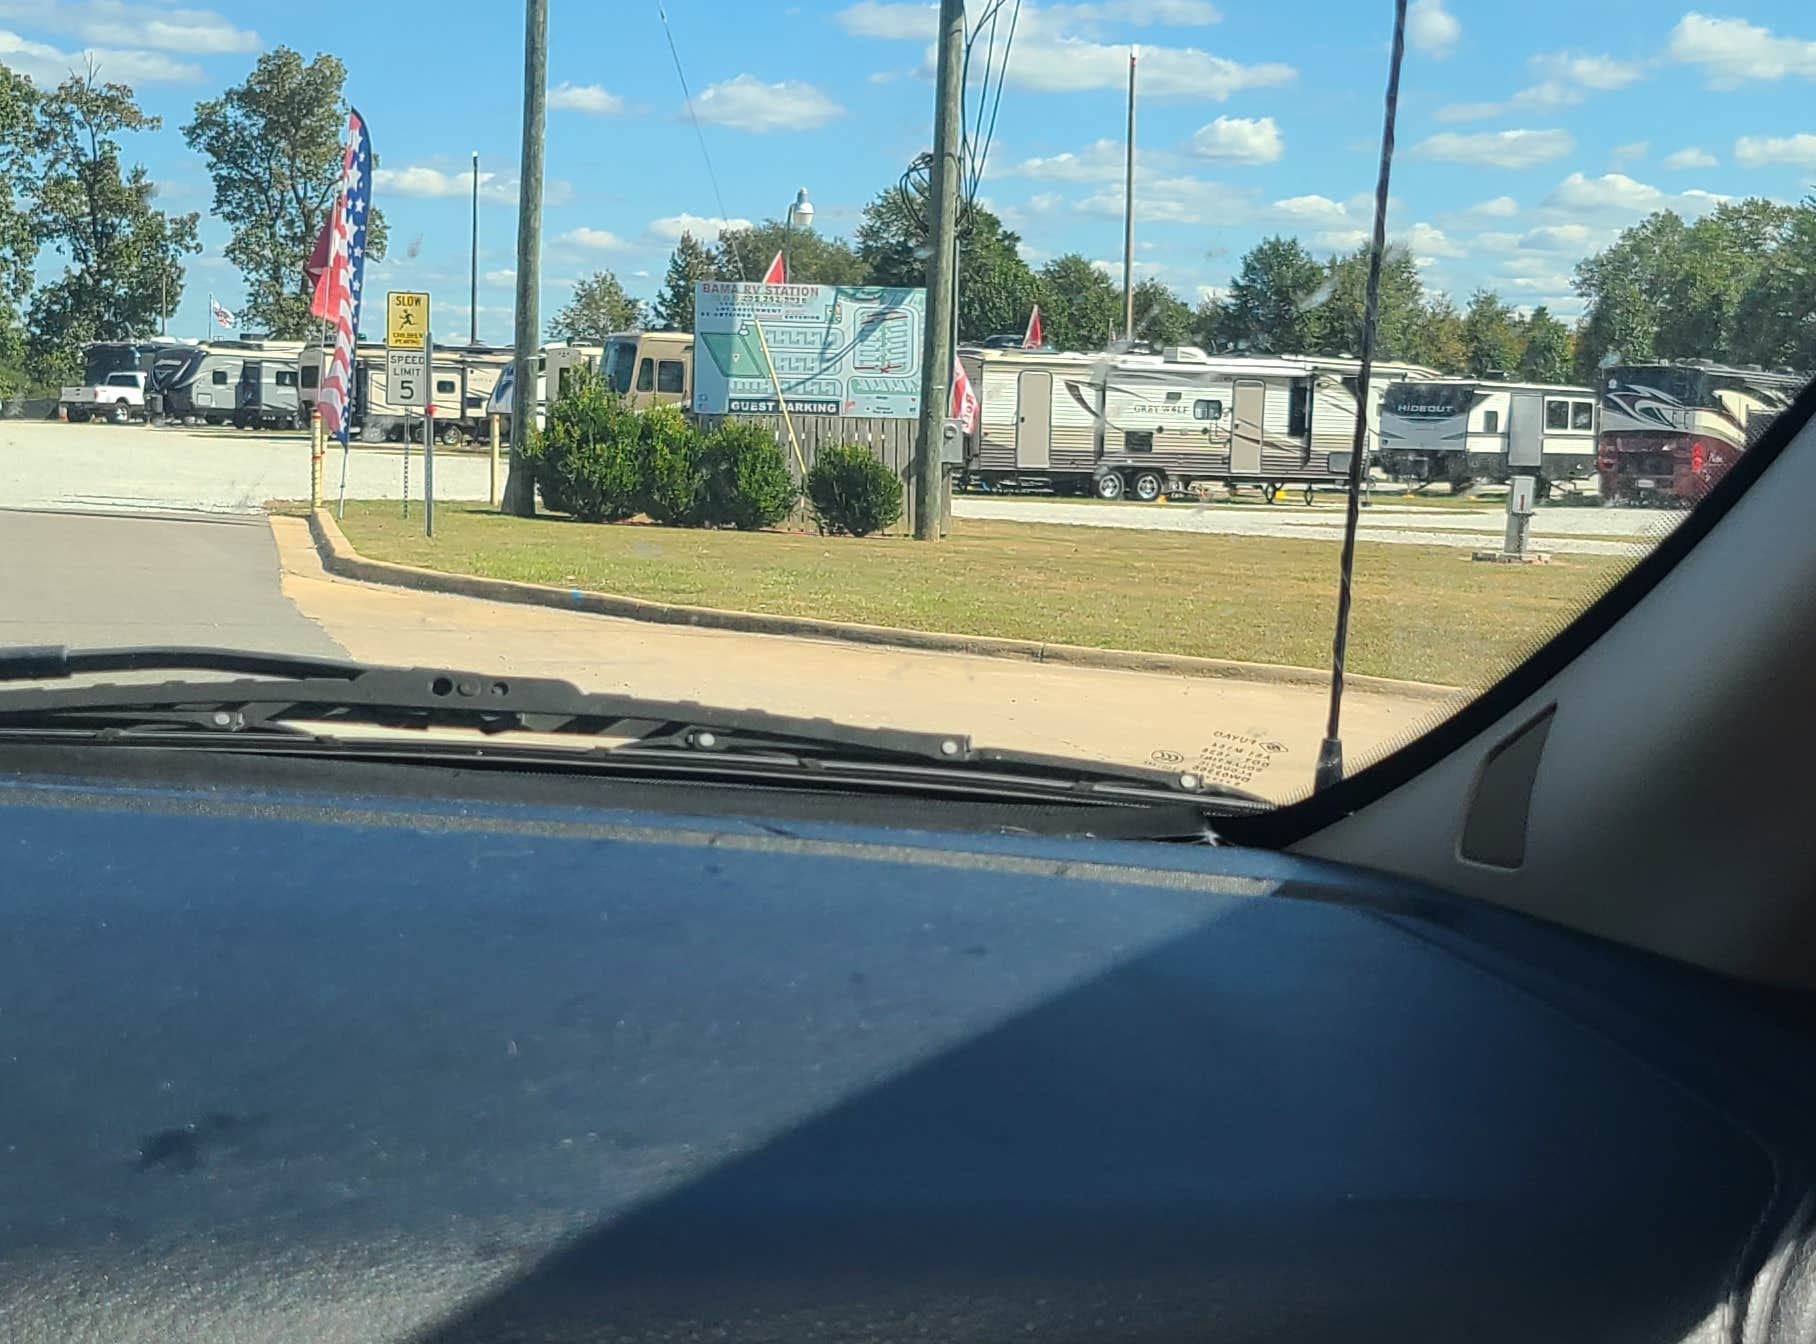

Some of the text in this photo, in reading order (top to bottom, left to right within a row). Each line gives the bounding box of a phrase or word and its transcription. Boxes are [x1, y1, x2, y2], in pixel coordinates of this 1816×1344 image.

[703, 283, 819, 297] BAMA RV STATION
[395, 295, 422, 307] SLOW
[390, 355, 425, 365] SPEED
[393, 368, 421, 376] LIMIT
[400, 380, 414, 399] 5
[730, 401, 776, 411] GUEST
[1397, 405, 1454, 413] HIDEOUT
